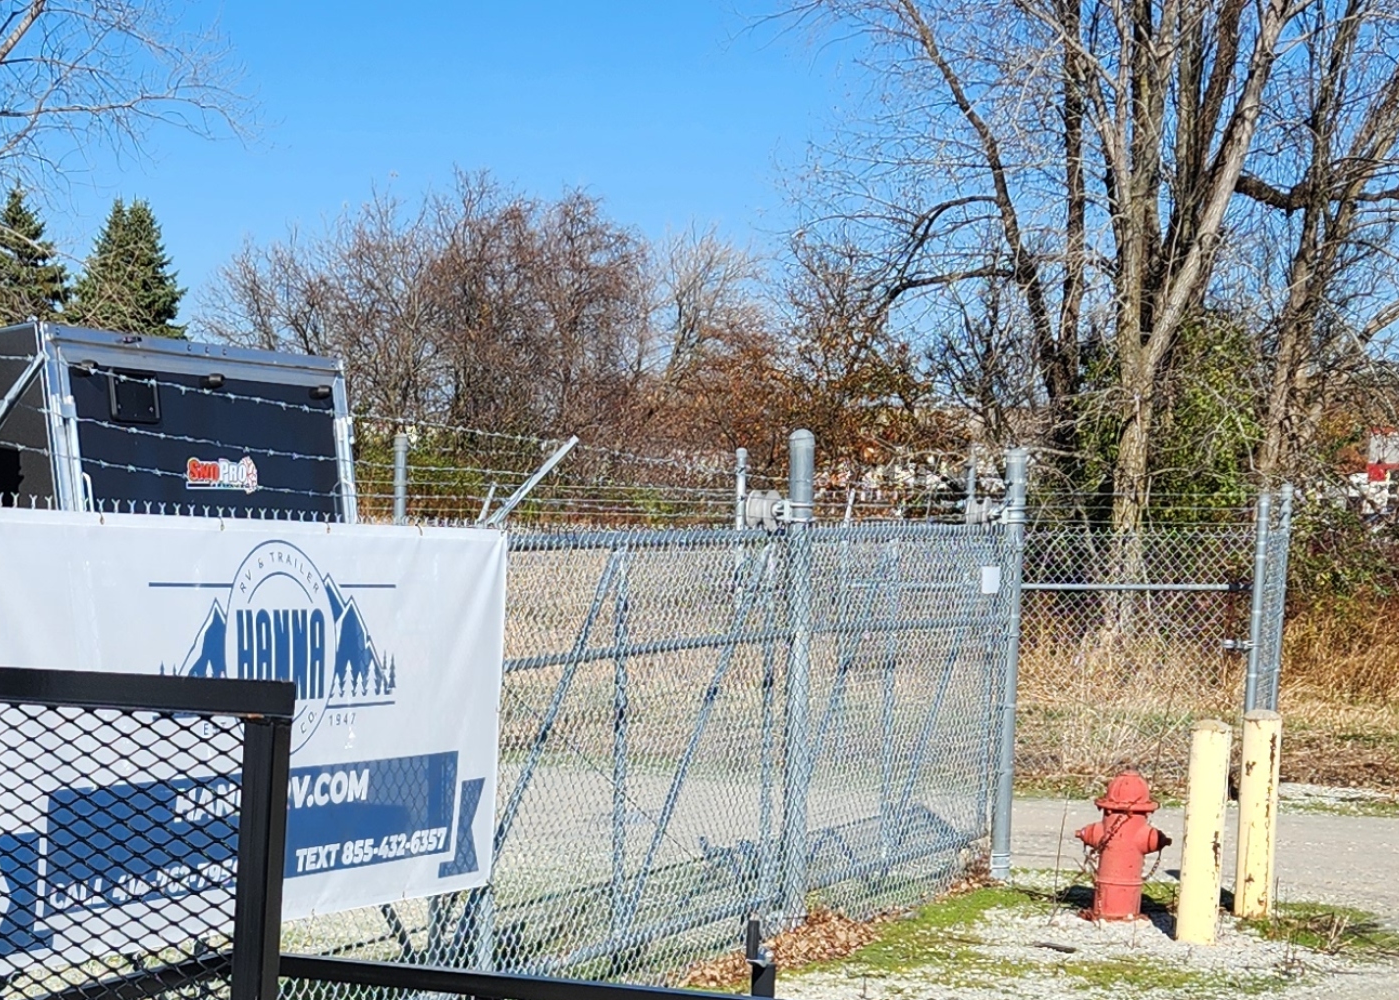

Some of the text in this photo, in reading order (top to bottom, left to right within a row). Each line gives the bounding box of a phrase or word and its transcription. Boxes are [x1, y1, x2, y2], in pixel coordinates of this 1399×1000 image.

[239, 571, 253, 594] RV
[269, 551, 321, 594] TRAILER
[235, 608, 325, 701] HANNA
[328, 711, 357, 727] 1947
[295, 843, 341, 873] TEXT
[341, 827, 447, 866] 855-432-6357
